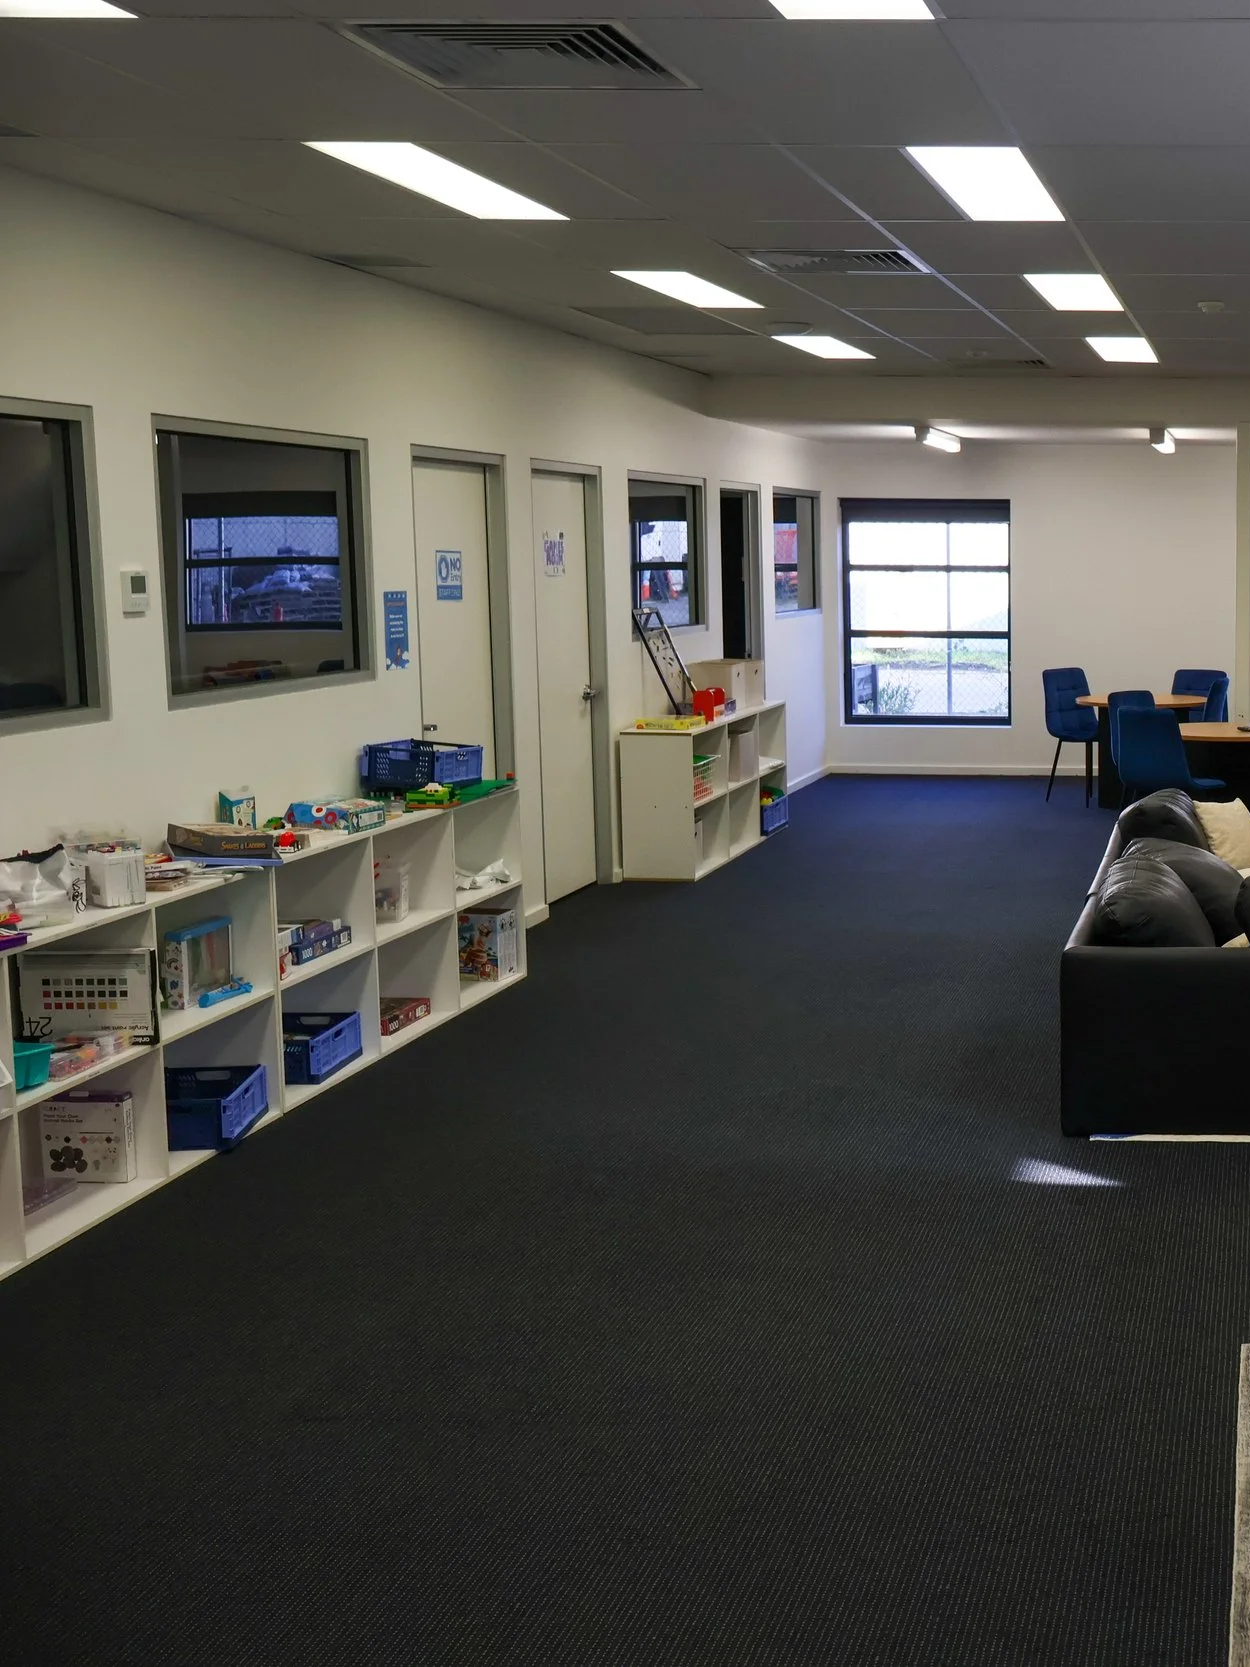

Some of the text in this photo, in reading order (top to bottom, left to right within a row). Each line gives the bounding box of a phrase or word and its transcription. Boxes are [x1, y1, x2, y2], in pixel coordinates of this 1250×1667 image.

[450, 557, 461, 572] NO
[302, 947, 313, 959] 1000
[25, 1016, 54, 1038] 24
[389, 1020, 399, 1031] 1000
